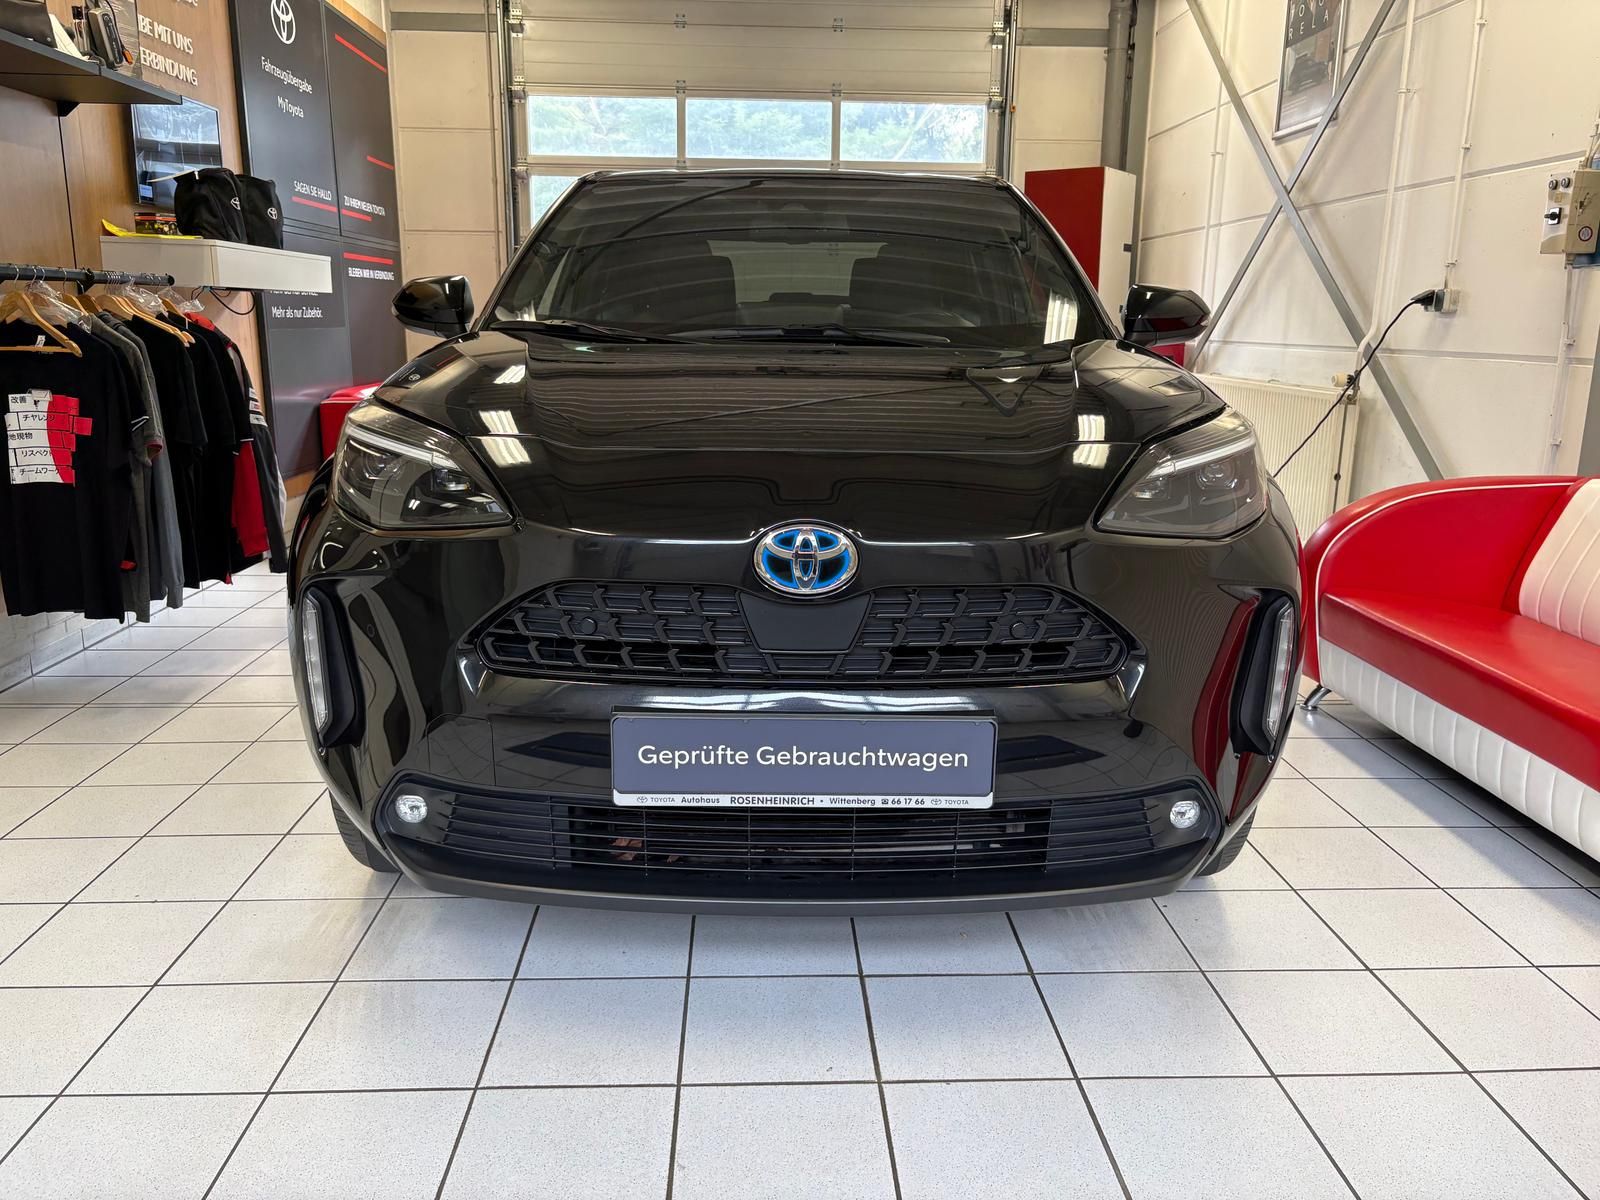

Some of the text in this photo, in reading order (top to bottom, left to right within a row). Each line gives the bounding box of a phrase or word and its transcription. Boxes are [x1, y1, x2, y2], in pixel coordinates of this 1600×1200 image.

[153, 21, 172, 45] MIT
[172, 30, 194, 55] UNS
[140, 46, 198, 86] ERBINDUNG
[261, 55, 313, 94] Fahrzeugübergabe
[277, 95, 304, 118] MyToyota
[294, 180, 332, 201] SAGEN SIE HALLO
[271, 305, 285, 318] Mehr
[286, 305, 294, 318] als
[294, 308, 303, 318] nur
[637, 744, 969, 772] Geprüfte Gebrauchtwagen
[681, 796, 720, 804] Autohaus
[730, 796, 815, 806] ROSENHEINRICH
[829, 797, 876, 806] Wittenberg
[891, 797, 902, 806] 66
[914, 798, 925, 806] 66
